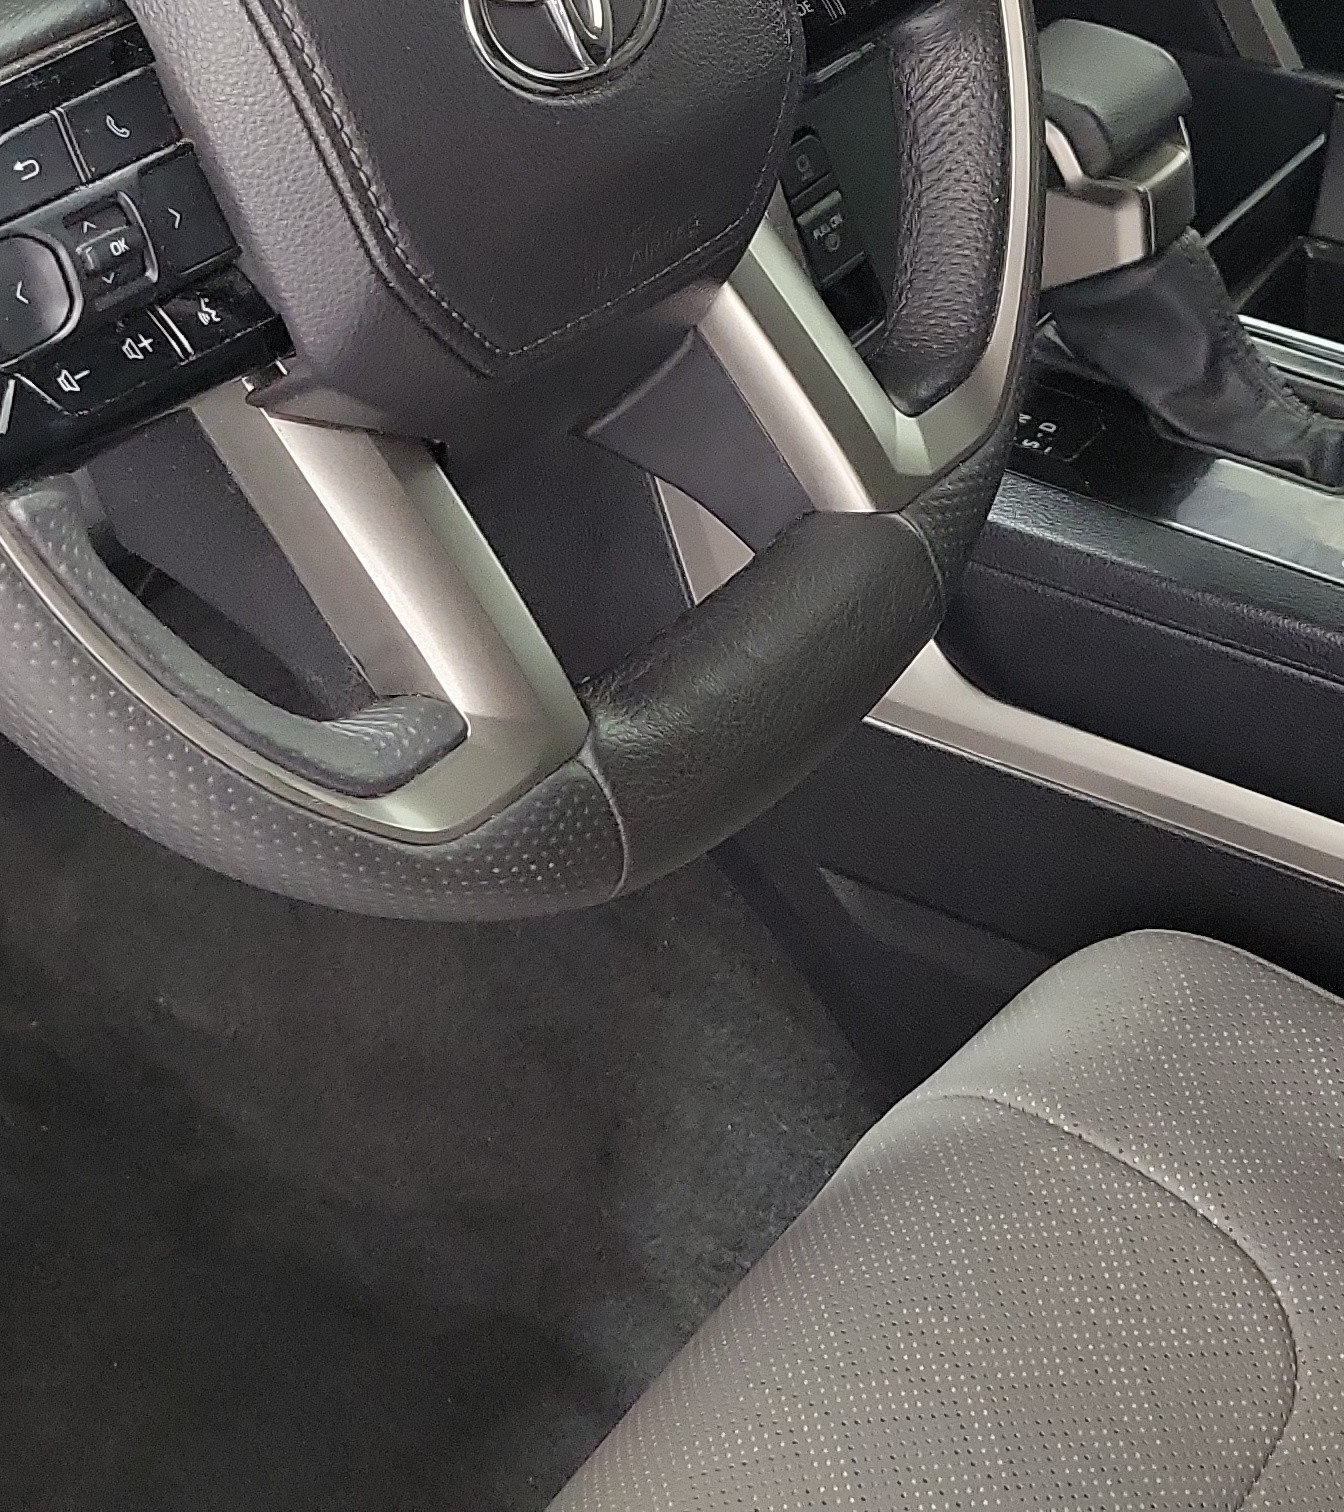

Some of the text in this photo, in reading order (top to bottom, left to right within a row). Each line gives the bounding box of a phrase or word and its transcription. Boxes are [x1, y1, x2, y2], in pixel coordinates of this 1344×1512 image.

[110, 237, 129, 256] OK
[1039, 422, 1057, 433] D
[1022, 438, 1041, 449] S
